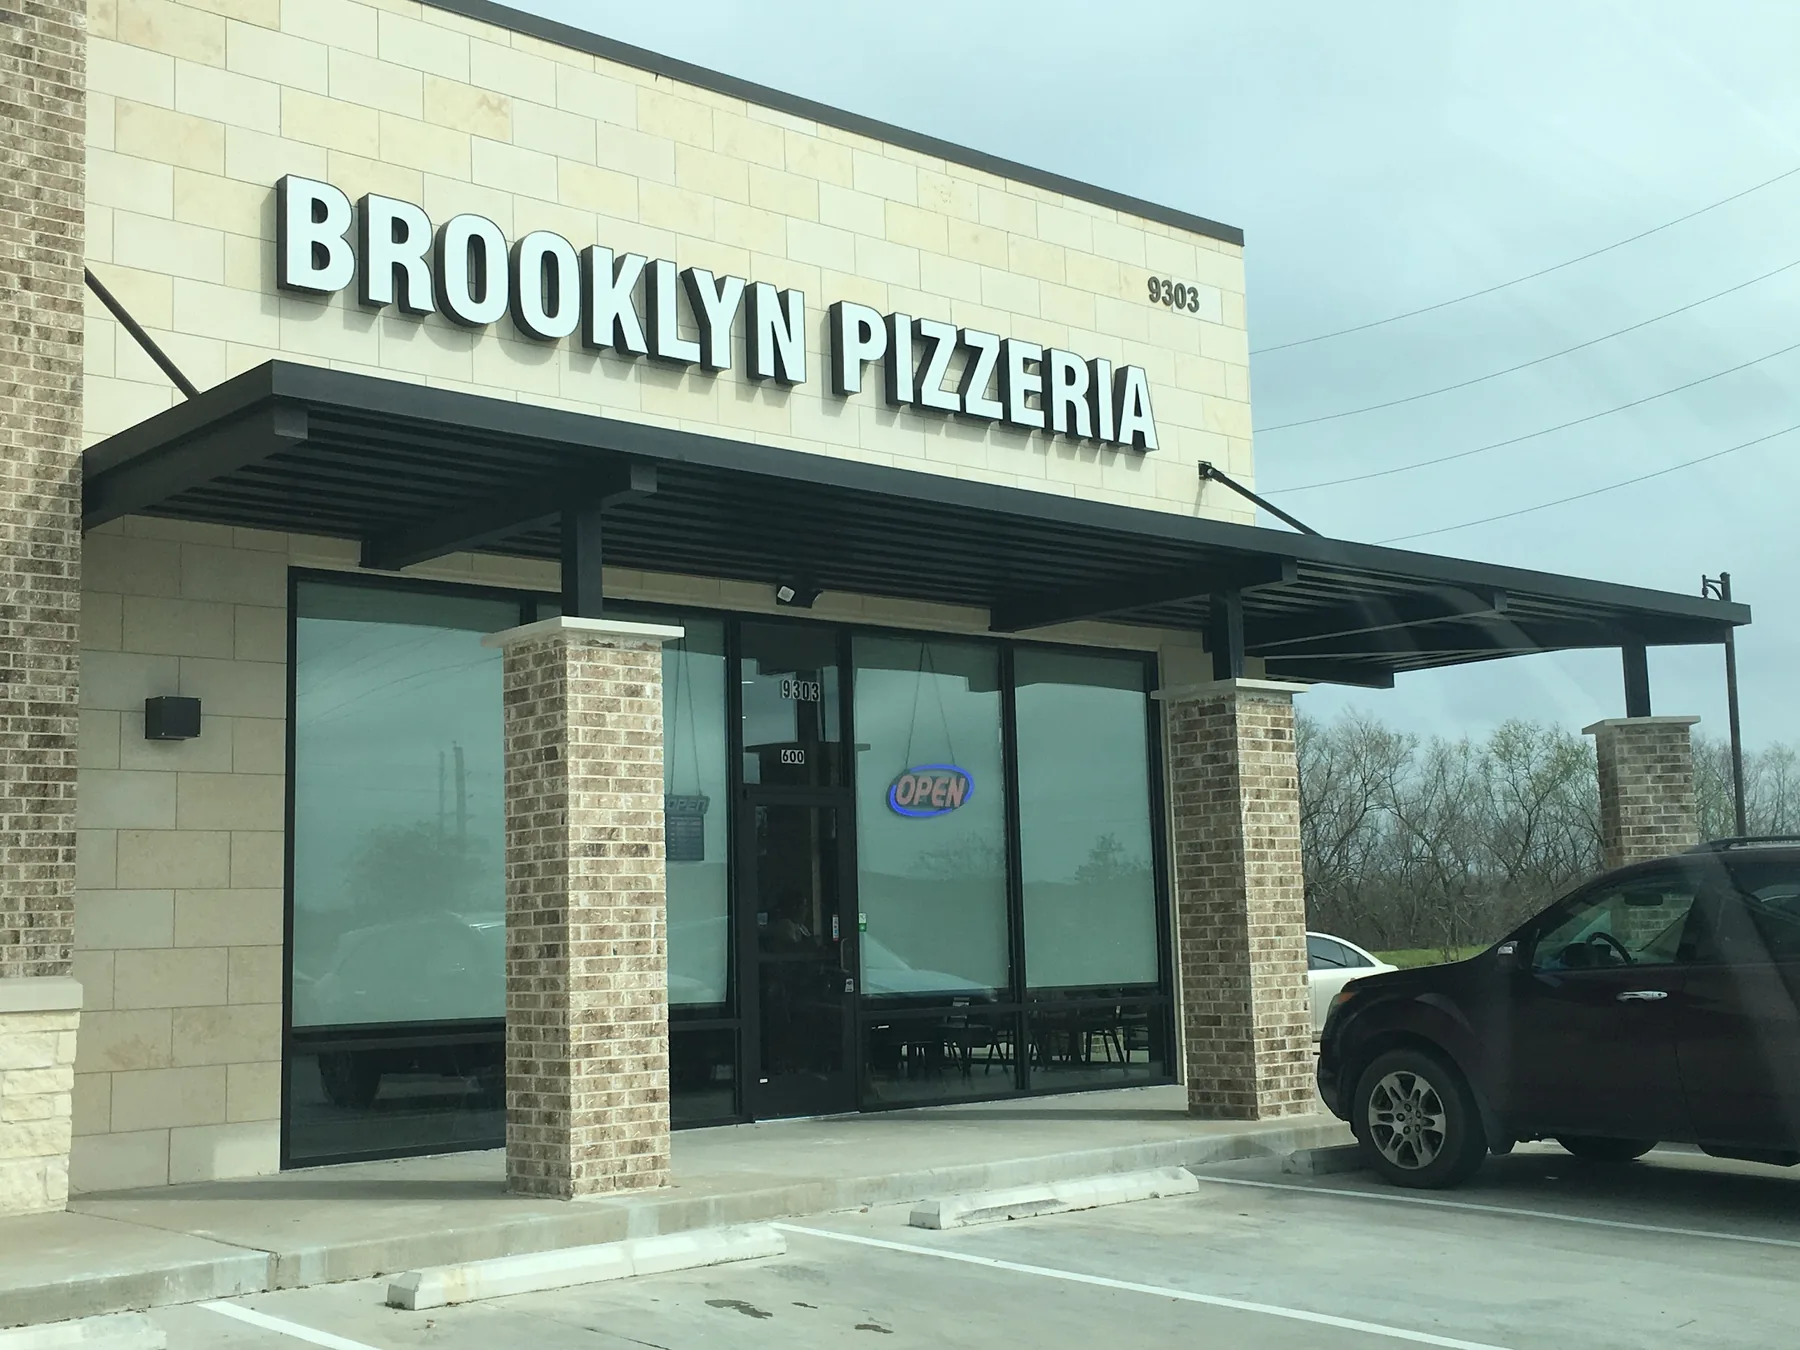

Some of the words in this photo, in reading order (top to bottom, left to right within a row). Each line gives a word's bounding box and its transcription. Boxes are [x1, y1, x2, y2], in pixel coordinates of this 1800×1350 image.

[1147, 276, 1200, 313] 9303
[277, 174, 807, 386] BROOKLYN
[830, 300, 1160, 452] PIZZERIA
[782, 680, 820, 701] 9303
[782, 750, 804, 763] 600
[896, 775, 966, 807] OPEN
